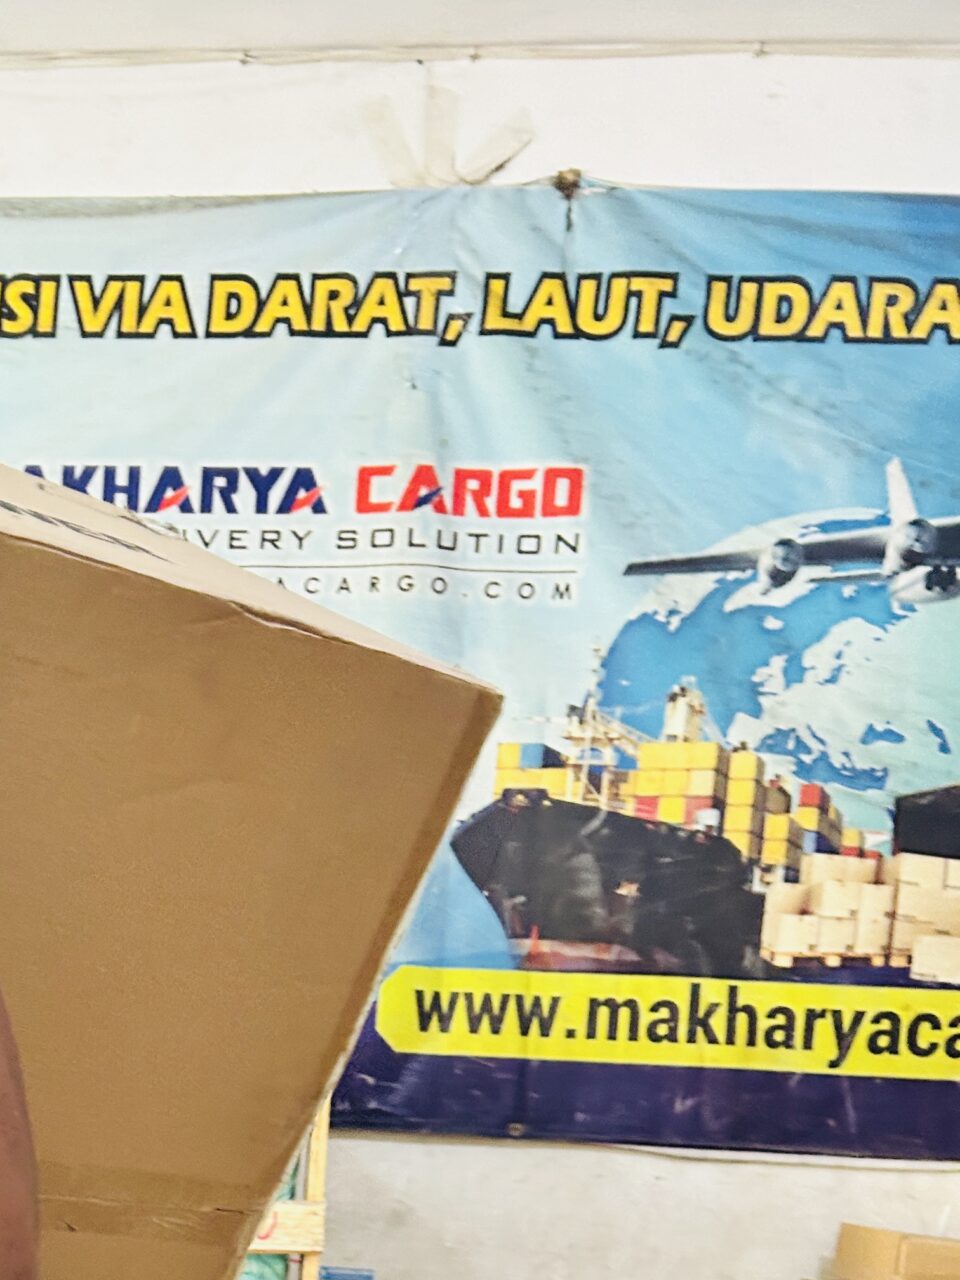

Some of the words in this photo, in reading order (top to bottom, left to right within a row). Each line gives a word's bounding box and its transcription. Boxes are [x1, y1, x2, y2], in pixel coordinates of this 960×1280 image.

[67, 273, 197, 338] VIA
[206, 272, 471, 347] DARAT,
[479, 270, 697, 349] LAUT,
[705, 274, 960, 345] UDARA
[24, 464, 328, 515] KHARYA
[355, 463, 585, 519] CARGO
[336, 528, 580, 556] SOLUTION
